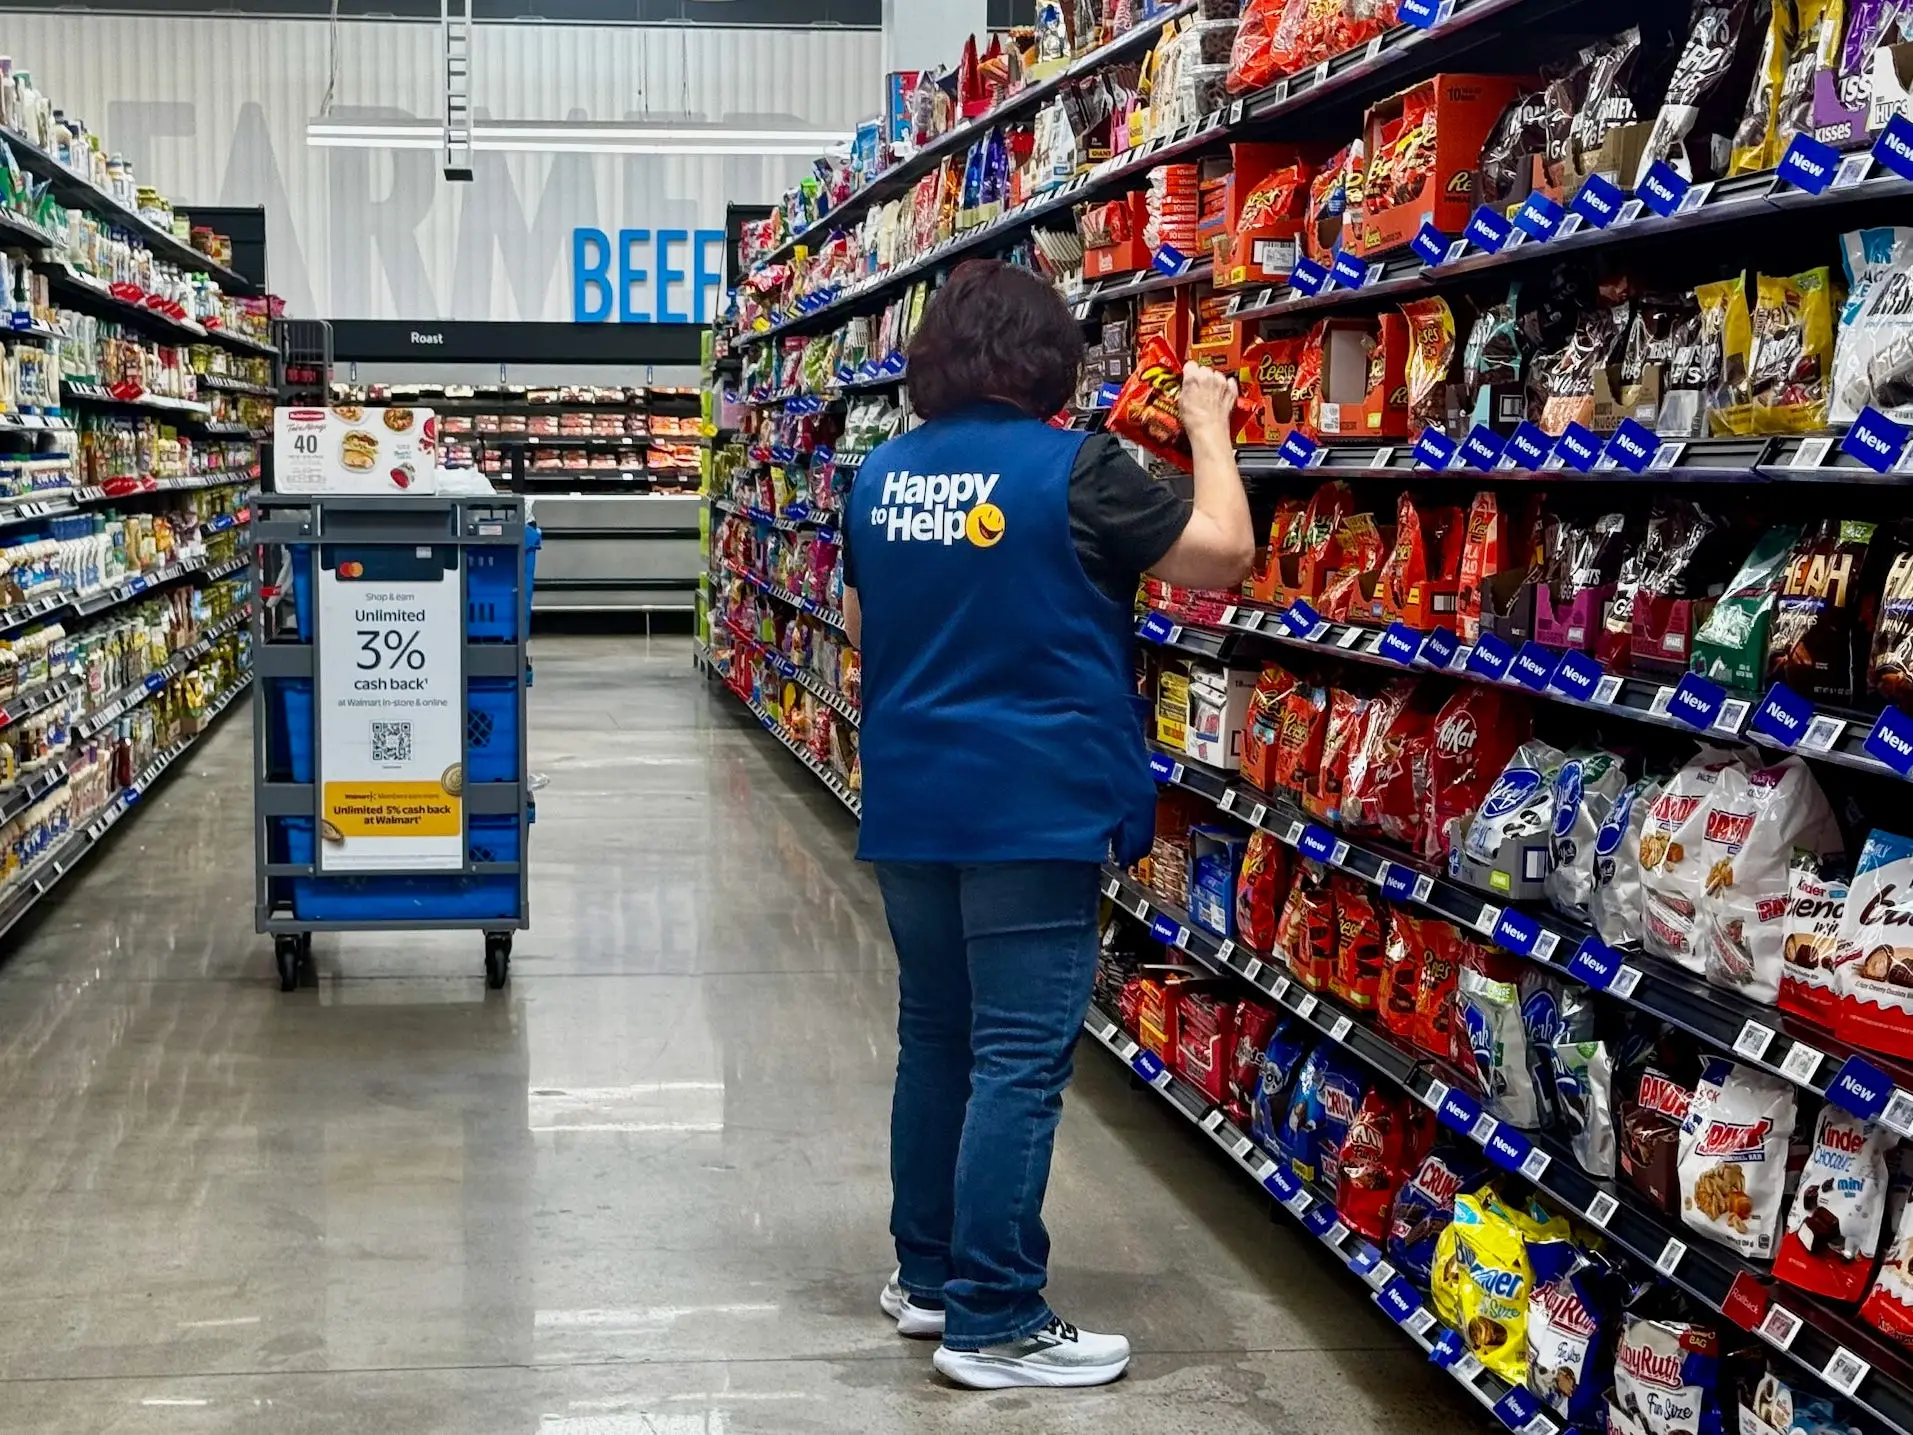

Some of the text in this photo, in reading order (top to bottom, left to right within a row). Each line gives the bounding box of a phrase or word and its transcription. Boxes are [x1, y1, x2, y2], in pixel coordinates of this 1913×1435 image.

[1790, 151, 1824, 176] New
[1649, 175, 1675, 202] New
[1583, 190, 1611, 213] New
[1525, 206, 1552, 228] New
[1474, 220, 1499, 240] New
[1420, 234, 1440, 254] New
[1157, 252, 1175, 268] New
[1336, 262, 1359, 278] New
[571, 228, 727, 324] BEEF
[1297, 269, 1317, 285] New
[410, 331, 444, 345] Roast
[294, 434, 318, 454] 40
[1286, 441, 1306, 457] New
[1421, 439, 1444, 458] New
[1469, 438, 1493, 458] New
[1515, 436, 1540, 457] New
[1565, 436, 1591, 458] New
[1617, 434, 1646, 457] New
[1856, 426, 1890, 454] New
[882, 470, 1000, 510] Happy
[871, 503, 967, 546] to Help
[365, 592, 387, 602] Shop
[396, 593, 415, 601] earn
[354, 610, 425, 623] Unlimited
[1290, 609, 1308, 626] New
[1148, 621, 1164, 634] New
[356, 629, 426, 670] 3%
[1386, 633, 1412, 653] New
[1427, 638, 1449, 655] New
[1476, 647, 1501, 665] New
[1520, 656, 1545, 676] New
[354, 678, 387, 690] cash
[1562, 665, 1590, 686] New
[338, 699, 346, 707] at
[347, 699, 382, 707] Walmart
[422, 699, 448, 707] online
[1679, 690, 1710, 712] New
[1766, 702, 1798, 729] New
[1878, 727, 1912, 755] New
[1150, 761, 1167, 772] New
[333, 805, 451, 815] Unlimited 5% cash back
[364, 816, 375, 825] at
[1305, 837, 1325, 851] New
[1386, 876, 1406, 891] New
[1155, 924, 1171, 936] New
[1502, 922, 1527, 941] New
[1579, 952, 1607, 974] New
[1141, 1058, 1155, 1073] New
[1841, 1076, 1875, 1101] New
[1446, 1101, 1470, 1121] New
[1492, 1134, 1518, 1157] New
[1272, 1171, 1291, 1191] New
[1419, 1161, 1462, 1198] CRUN
[1836, 1177, 1864, 1193] mini
[1389, 1289, 1408, 1310] New
[1731, 1287, 1759, 1315] Rollback
[1689, 1335, 1708, 1349] BAG
[1505, 1396, 1525, 1417] New
[1666, 1401, 1694, 1422] Size
